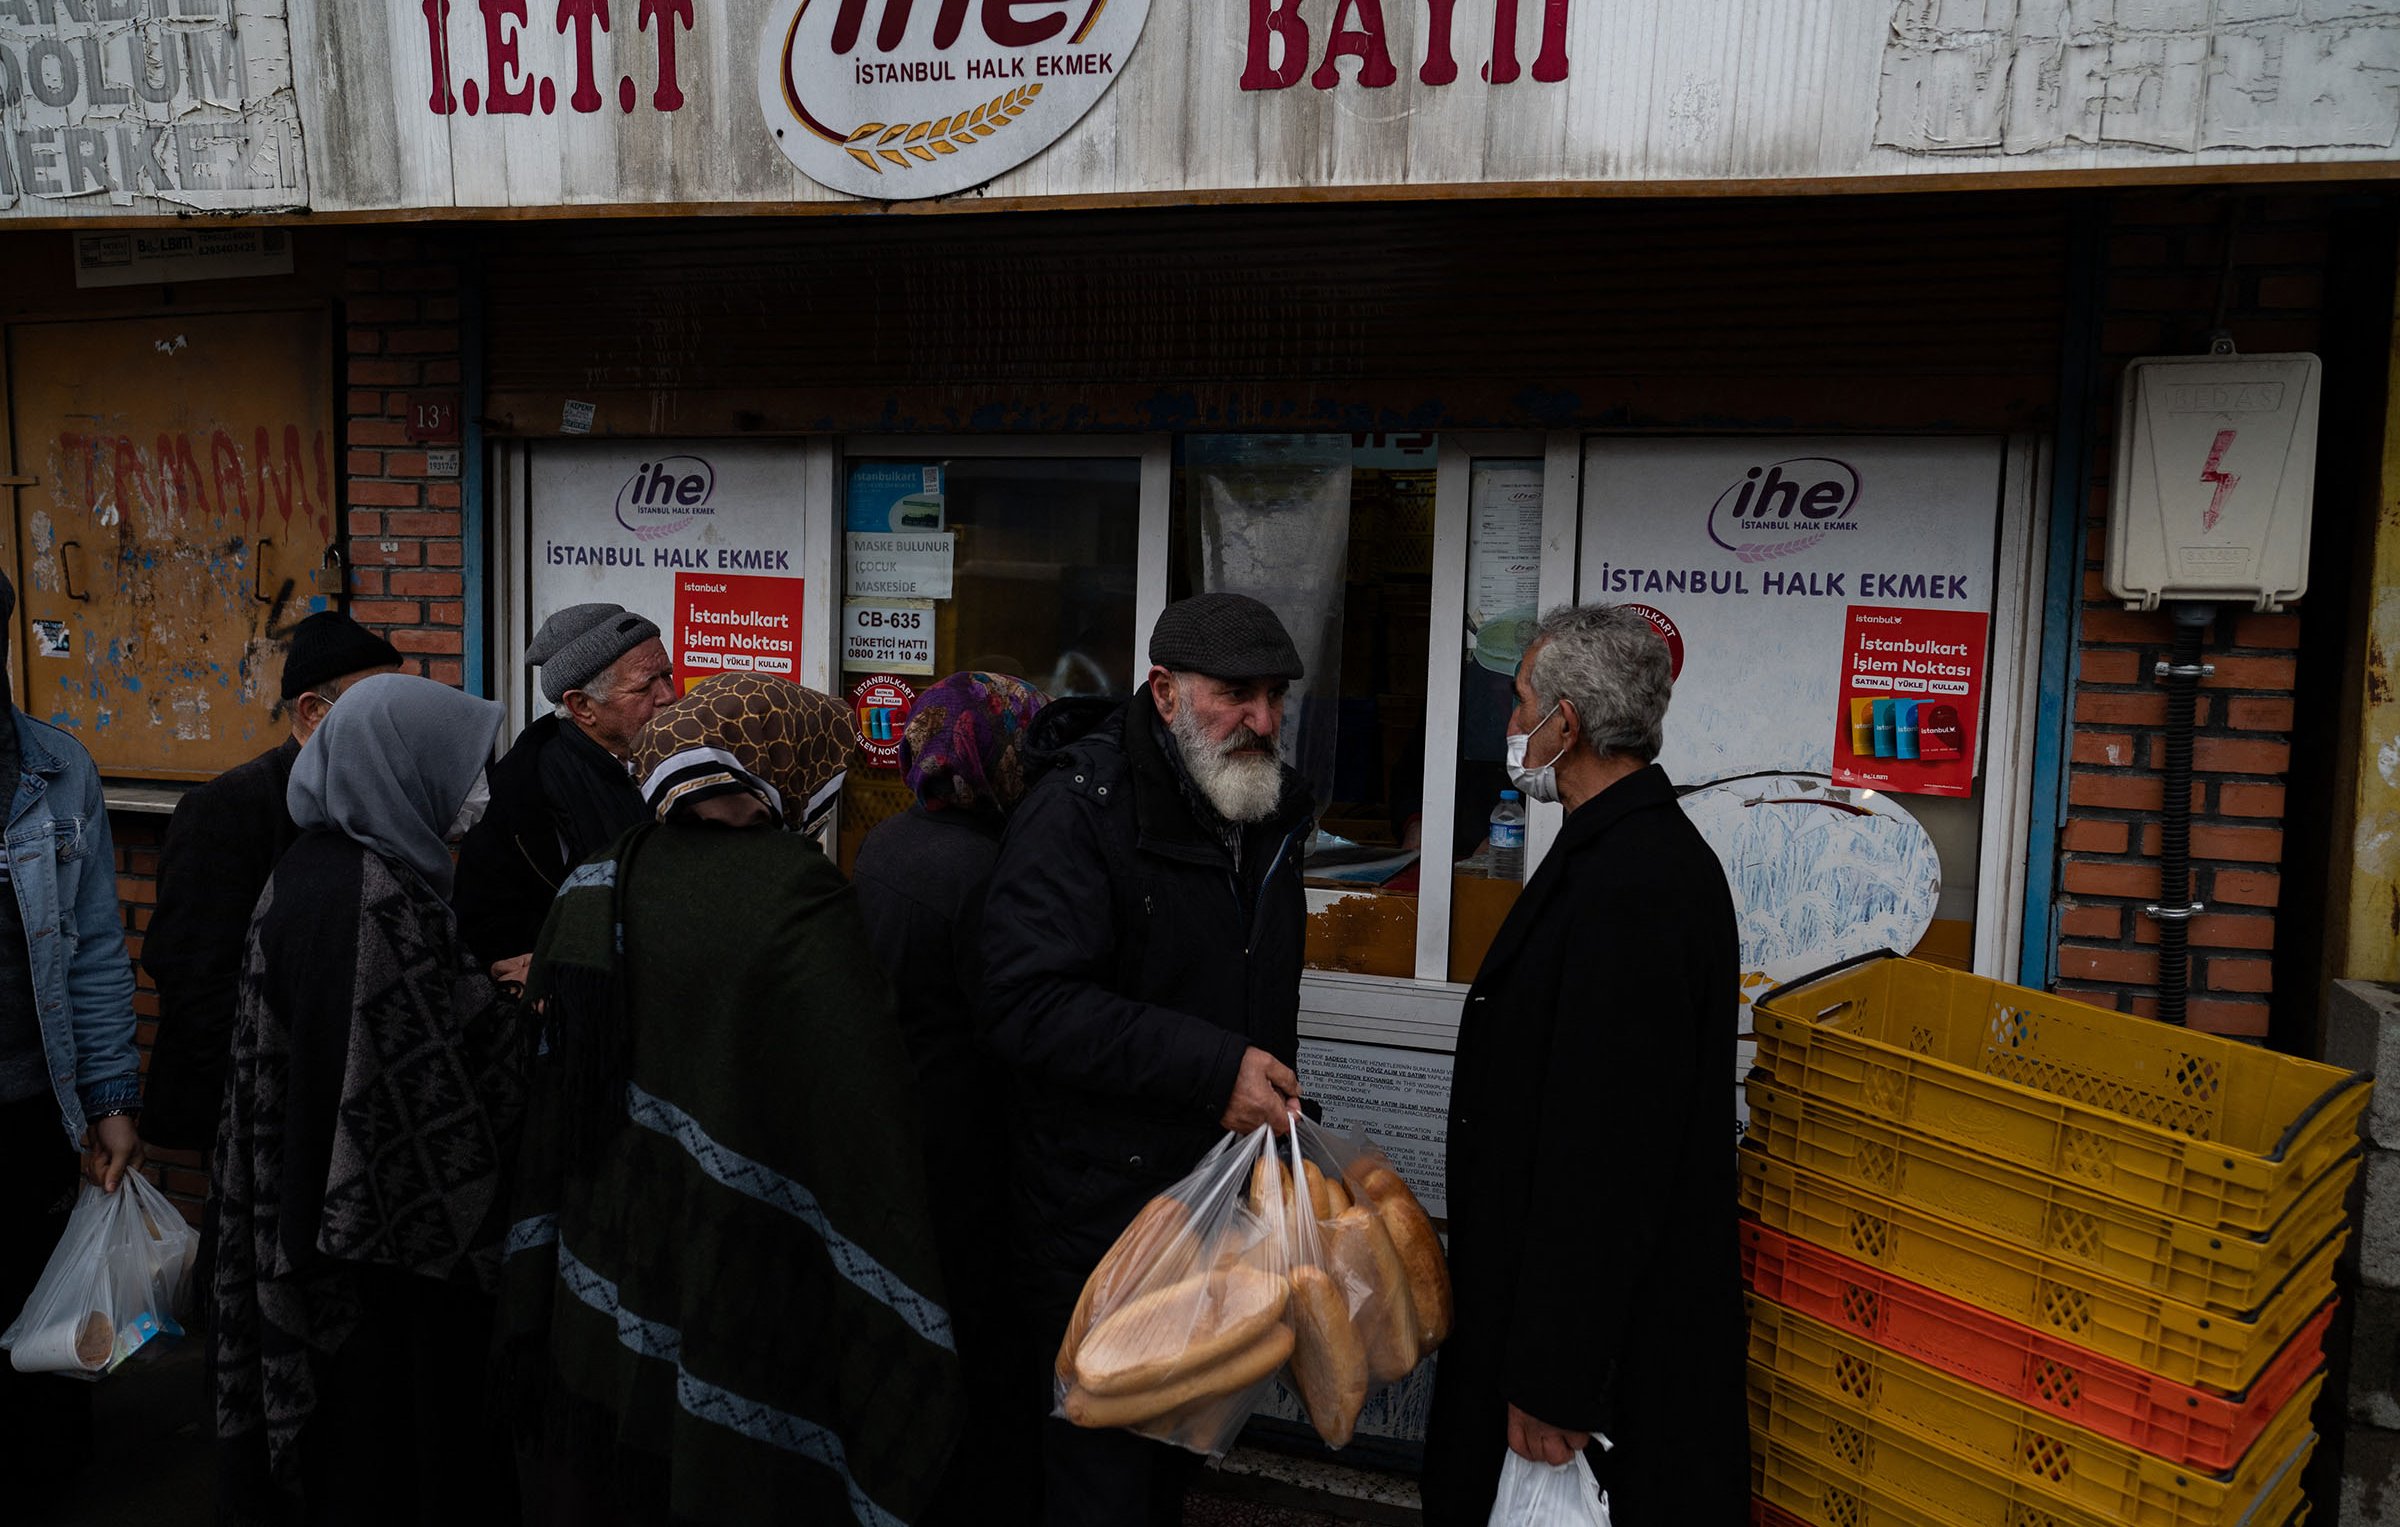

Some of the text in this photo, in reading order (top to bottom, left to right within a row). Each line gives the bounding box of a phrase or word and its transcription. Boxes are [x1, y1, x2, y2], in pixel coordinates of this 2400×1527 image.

[855, 53, 1114, 85] İSTANBUL HALK EKMEK
[60, 424, 330, 545] TAMAM!
[631, 462, 705, 506] ihe
[1731, 466, 1845, 519] ihe
[637, 505, 715, 515] İSTANBUL HALK EKMEK
[1741, 518, 1859, 531] İSTANBUL HALK EKMEK
[546, 540, 789, 570] İSTANBUL HALK EKMEK
[854, 541, 950, 552] MASKE BULUNUR
[855, 580, 917, 592] MASKESİDE
[1602, 562, 1969, 600] İSTANBUL HALK EKMEK
[690, 603, 789, 628] İstanbulkart
[858, 611, 920, 629] CB-635
[684, 625, 793, 652] İşlem Noktası
[849, 636, 927, 649] TÜKETİCİ HATTI
[1860, 633, 1967, 656] İstanbulkart
[687, 655, 709, 664] SATIN
[726, 657, 750, 666] YÜKLE
[758, 660, 788, 669] KULLAN
[848, 649, 928, 661] 0800 211 10 49
[1853, 653, 1971, 677] İşlem Noktası
[853, 675, 916, 700] İSTANBULKART
[1855, 678, 1879, 686] SATIN
[1898, 680, 1923, 689] YÜKLE
[1932, 684, 1965, 692] KULLAN
[1417, 1083, 1449, 1091] WORKPLAC
